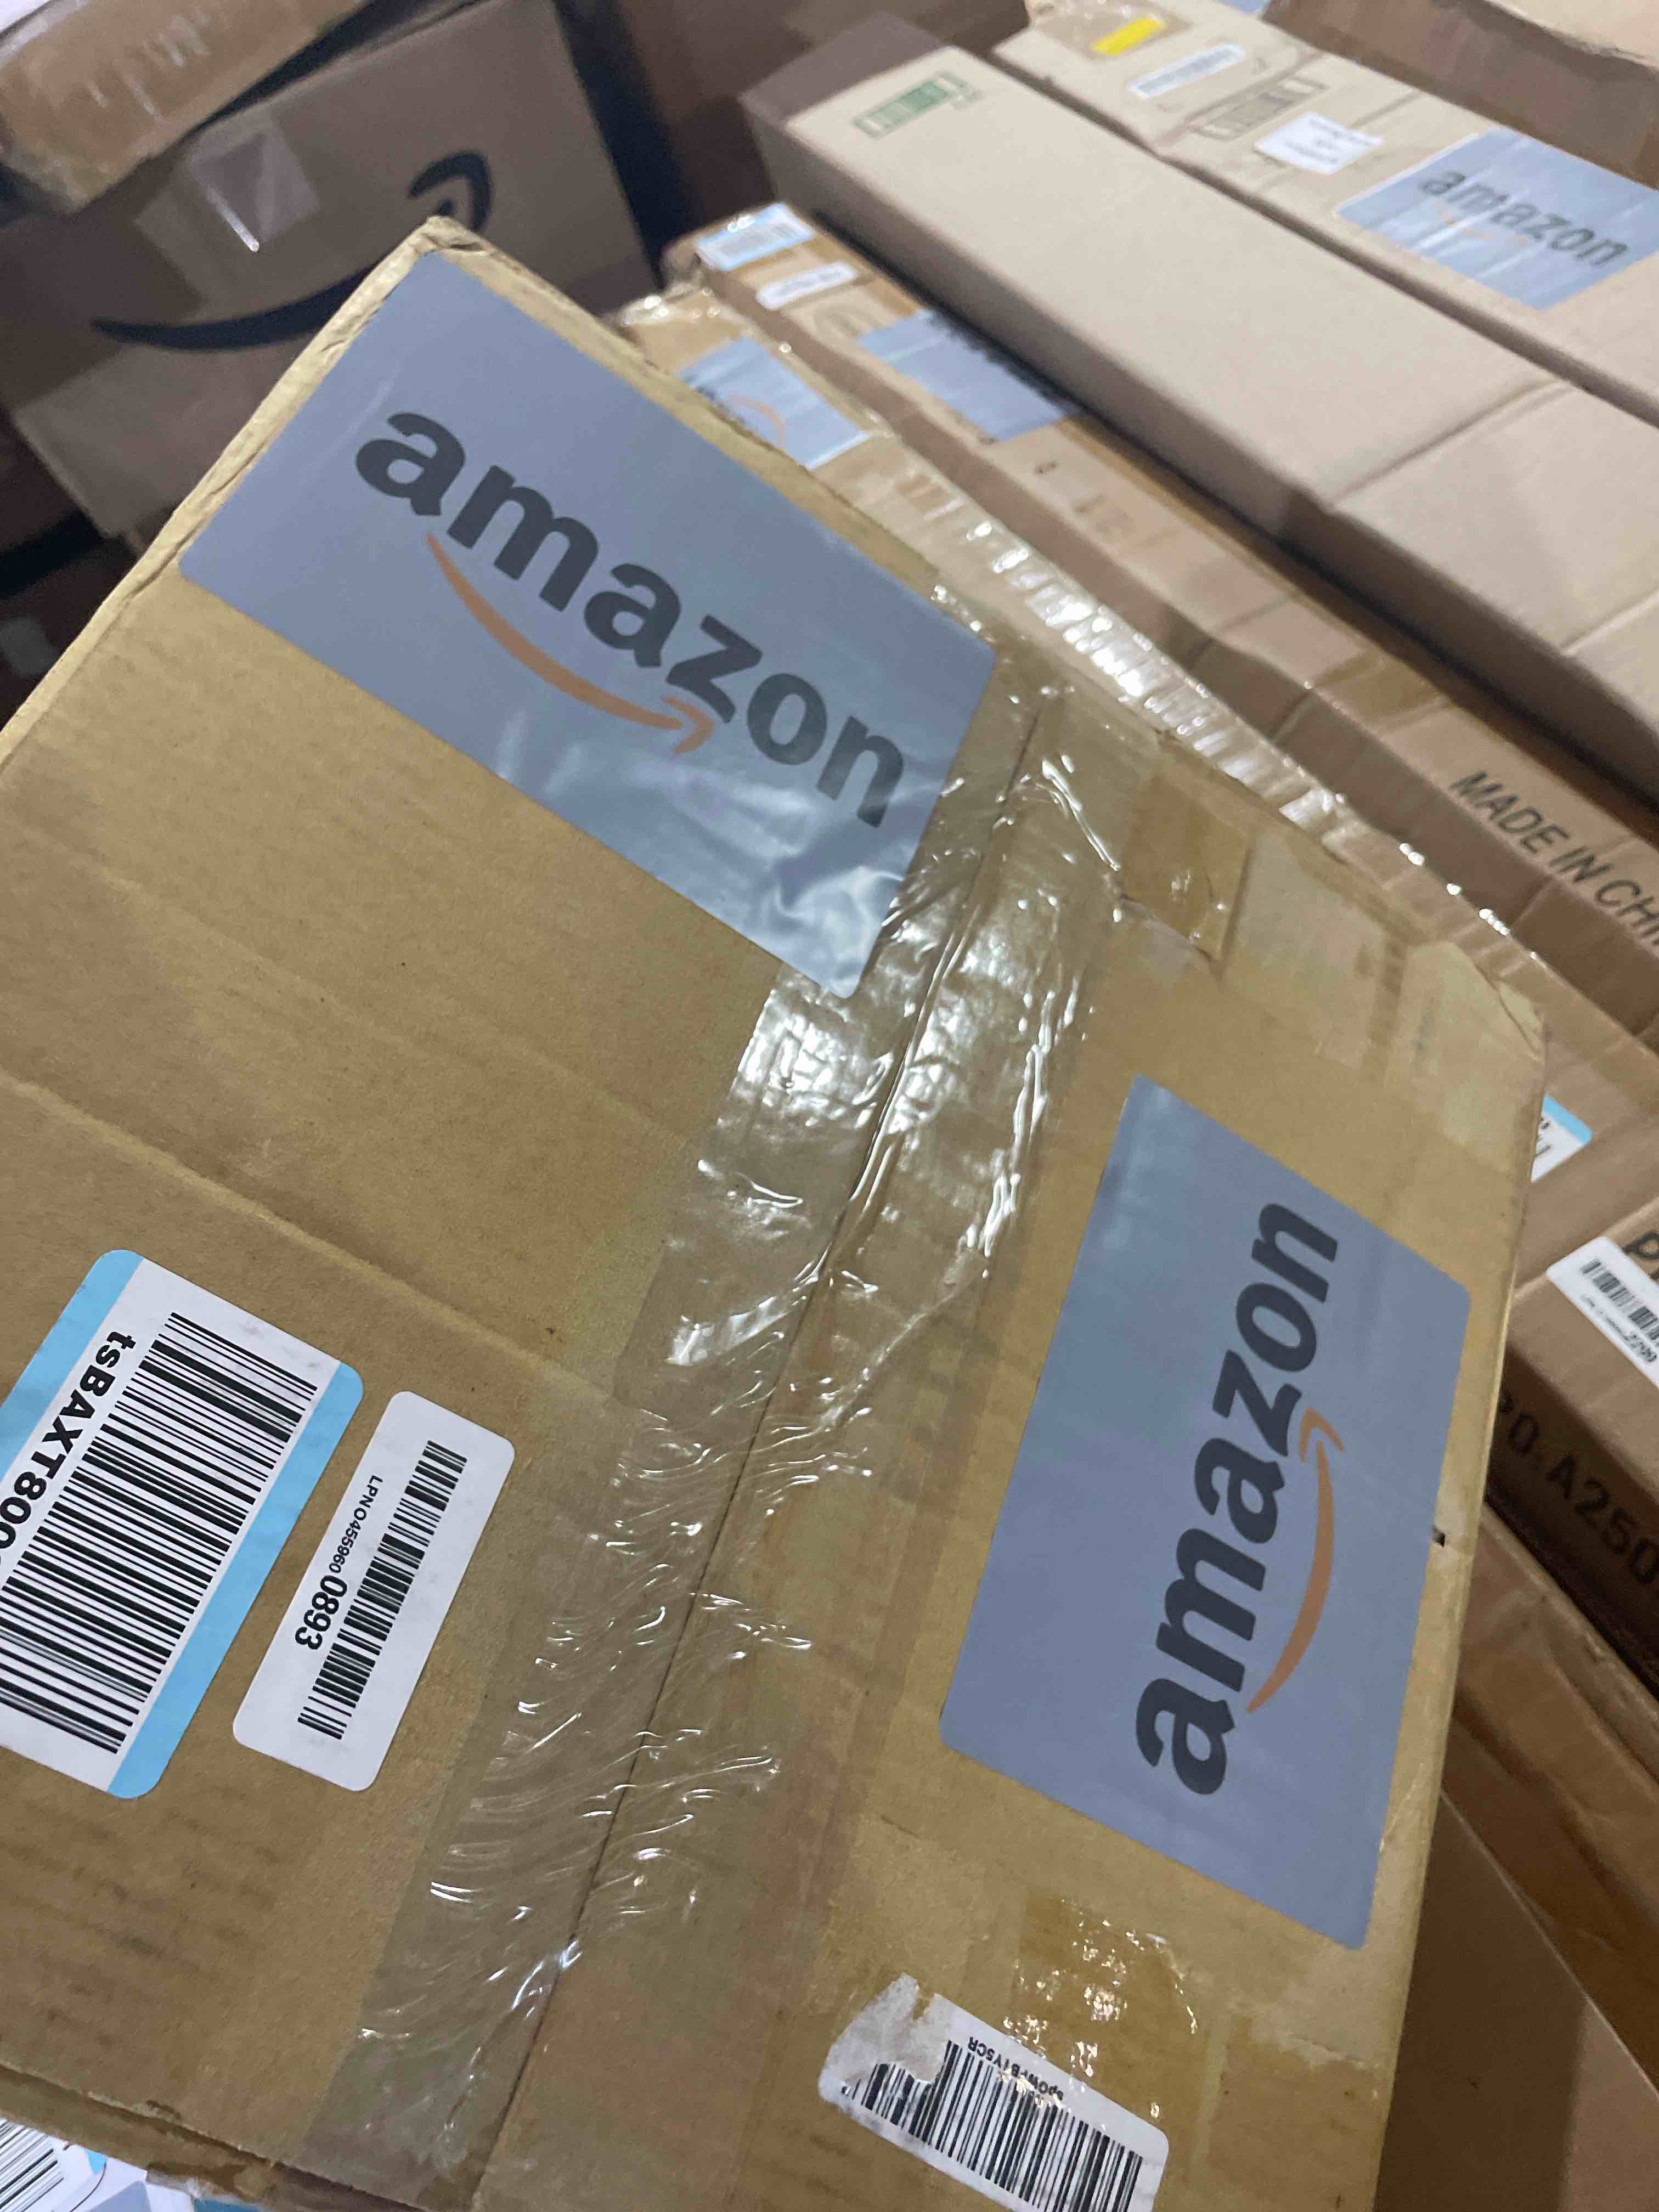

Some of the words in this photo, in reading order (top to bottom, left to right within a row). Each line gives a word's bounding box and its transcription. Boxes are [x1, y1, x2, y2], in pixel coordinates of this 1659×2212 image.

[1418, 171, 1628, 267] amazon
[355, 411, 904, 827] amazon
[1449, 771, 1571, 854] MADE
[1548, 847, 1613, 883] IN
[1135, 1203, 1338, 1795] amazon
